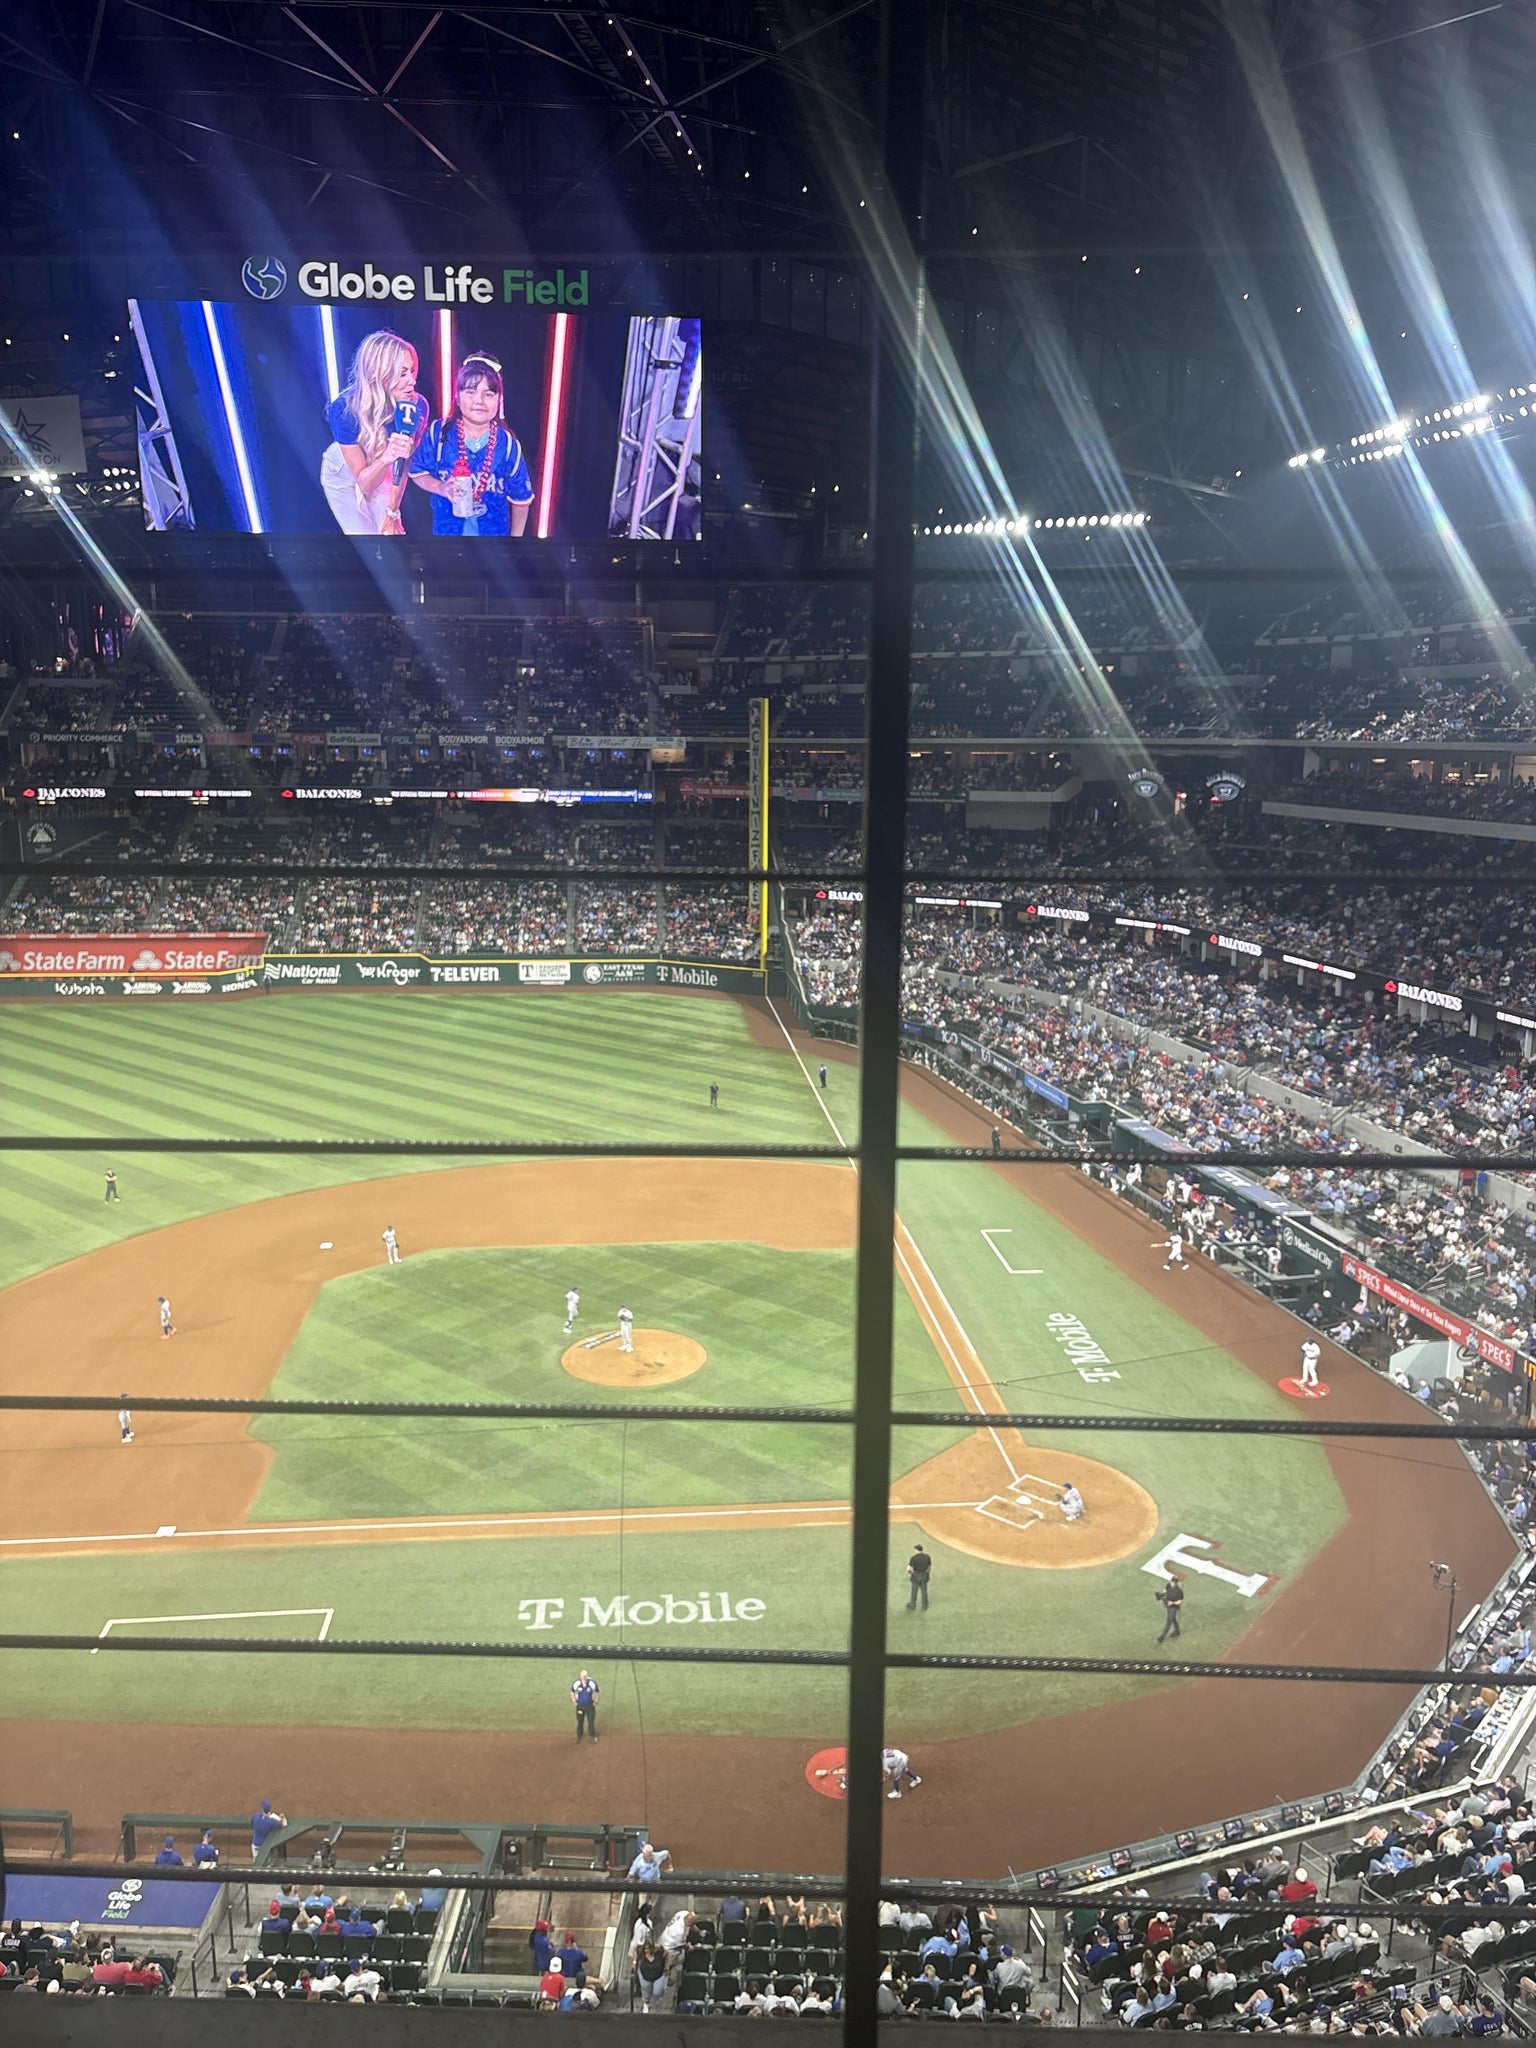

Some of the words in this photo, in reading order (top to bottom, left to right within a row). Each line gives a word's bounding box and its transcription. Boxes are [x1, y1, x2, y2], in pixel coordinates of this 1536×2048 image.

[298, 261, 415, 301] Globe
[424, 265, 495, 303] Life
[503, 269, 589, 306] Field
[438, 470, 505, 494] TXAS
[43, 733, 78, 742] PRIORITY
[80, 734, 123, 743] COMMERCE
[176, 733, 203, 744] 105.3
[438, 734, 489, 744] BODYARMOR
[495, 736, 545, 745] BODYARMOR
[37, 787, 106, 798] BALCONES
[295, 788, 362, 799] BALCONES
[828, 890, 863, 901] BALCO
[1037, 905, 1090, 922] BALCONES
[1218, 934, 1262, 957] BALCONES
[281, 963, 341, 979] National
[376, 961, 421, 986] Kroger
[671, 967, 718, 987] Mobile
[54, 981, 106, 996] Kubota
[221, 979, 258, 993] HONDA
[1397, 981, 1463, 1012] BALCONES
[1294, 1235, 1320, 1260] Medical
[1357, 1267, 1380, 1291] SPEC'S
[1045, 1312, 1111, 1366] Mobile
[1482, 1339, 1511, 1367] SPEC'S
[1140, 1533, 1271, 1598] T
[577, 1591, 767, 1628] Mobile
[108, 1891, 142, 1902] Globe
[108, 1900, 131, 1910] Life
[101, 1909, 130, 1919] Field
